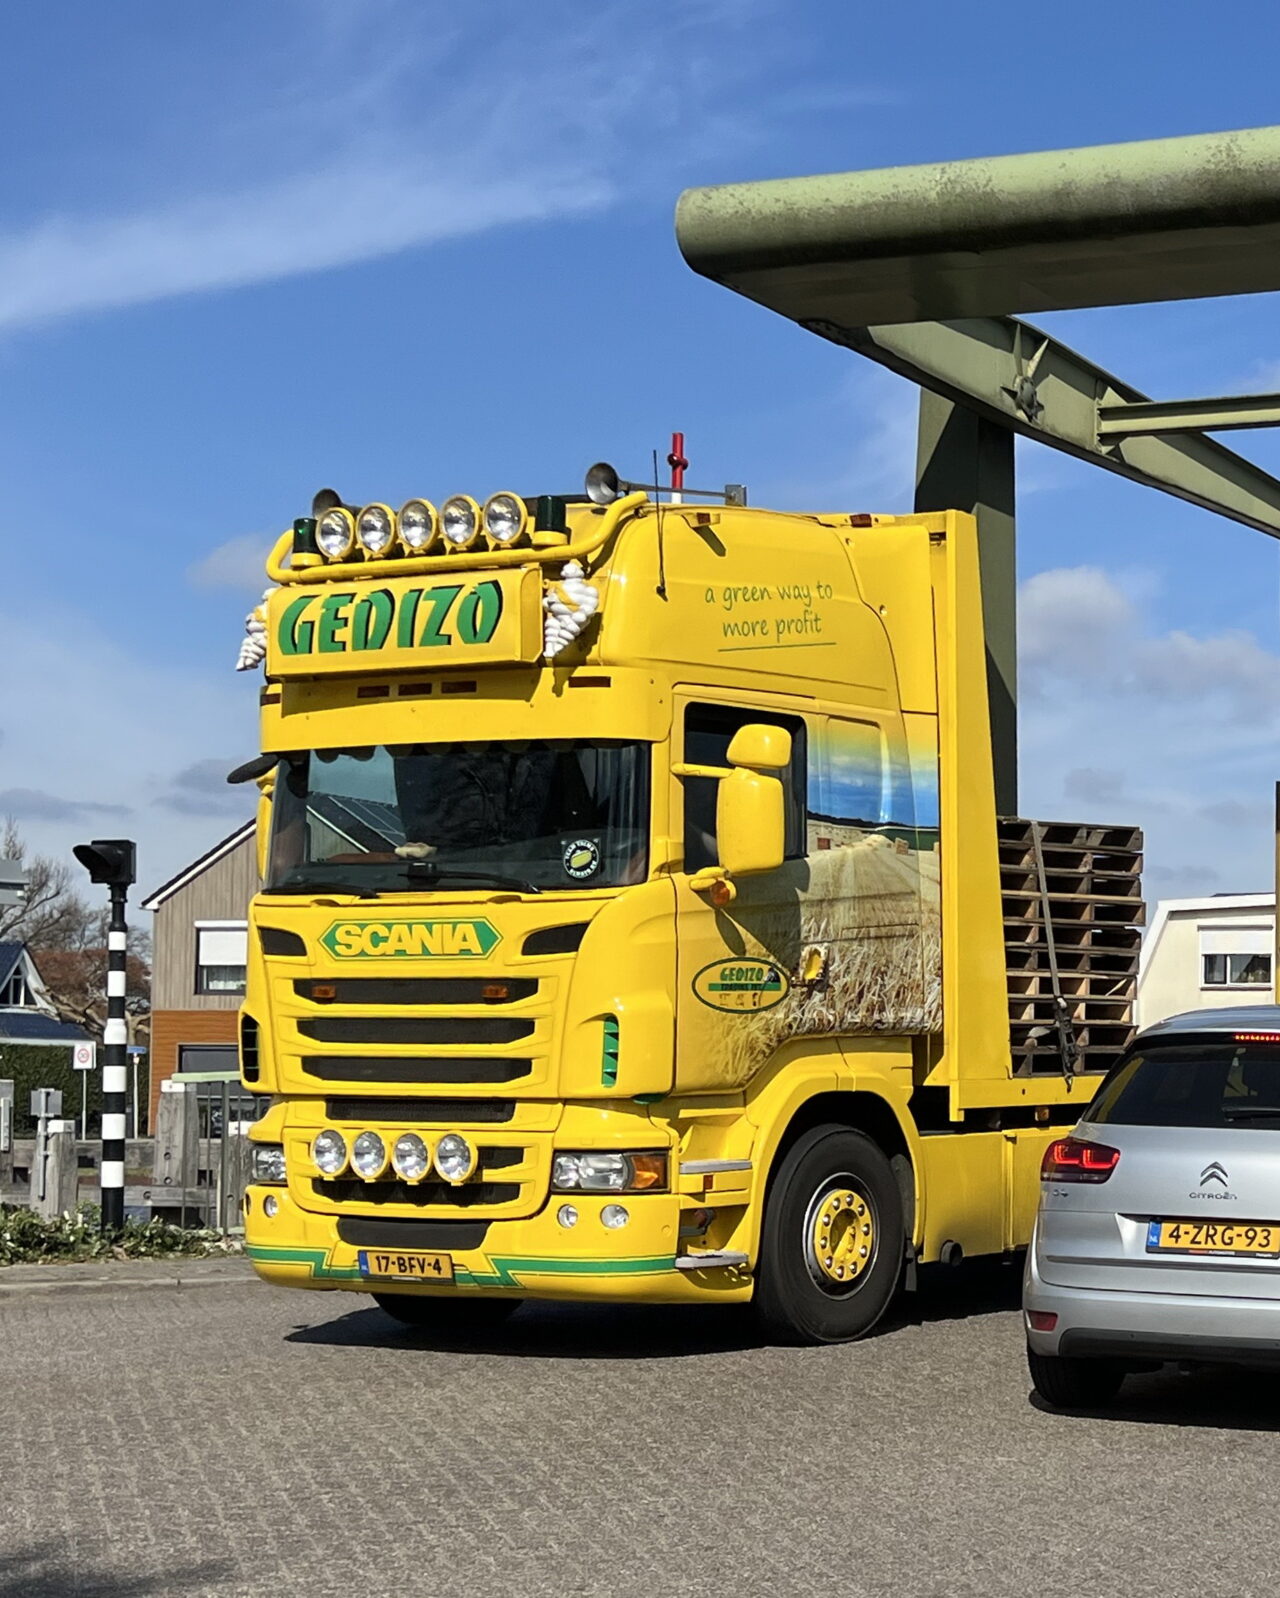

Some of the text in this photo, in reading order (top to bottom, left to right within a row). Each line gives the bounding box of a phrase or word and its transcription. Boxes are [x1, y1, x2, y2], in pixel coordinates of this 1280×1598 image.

[705, 580, 833, 611] a green way to
[278, 579, 503, 655] GEDIZO
[723, 609, 822, 643] more profit
[334, 923, 483, 957] SCANIA
[720, 967, 763, 981] GEDIZO
[1168, 1224, 1272, 1248] 4-ZRG-93
[375, 1255, 442, 1275] 17-BFV-4
